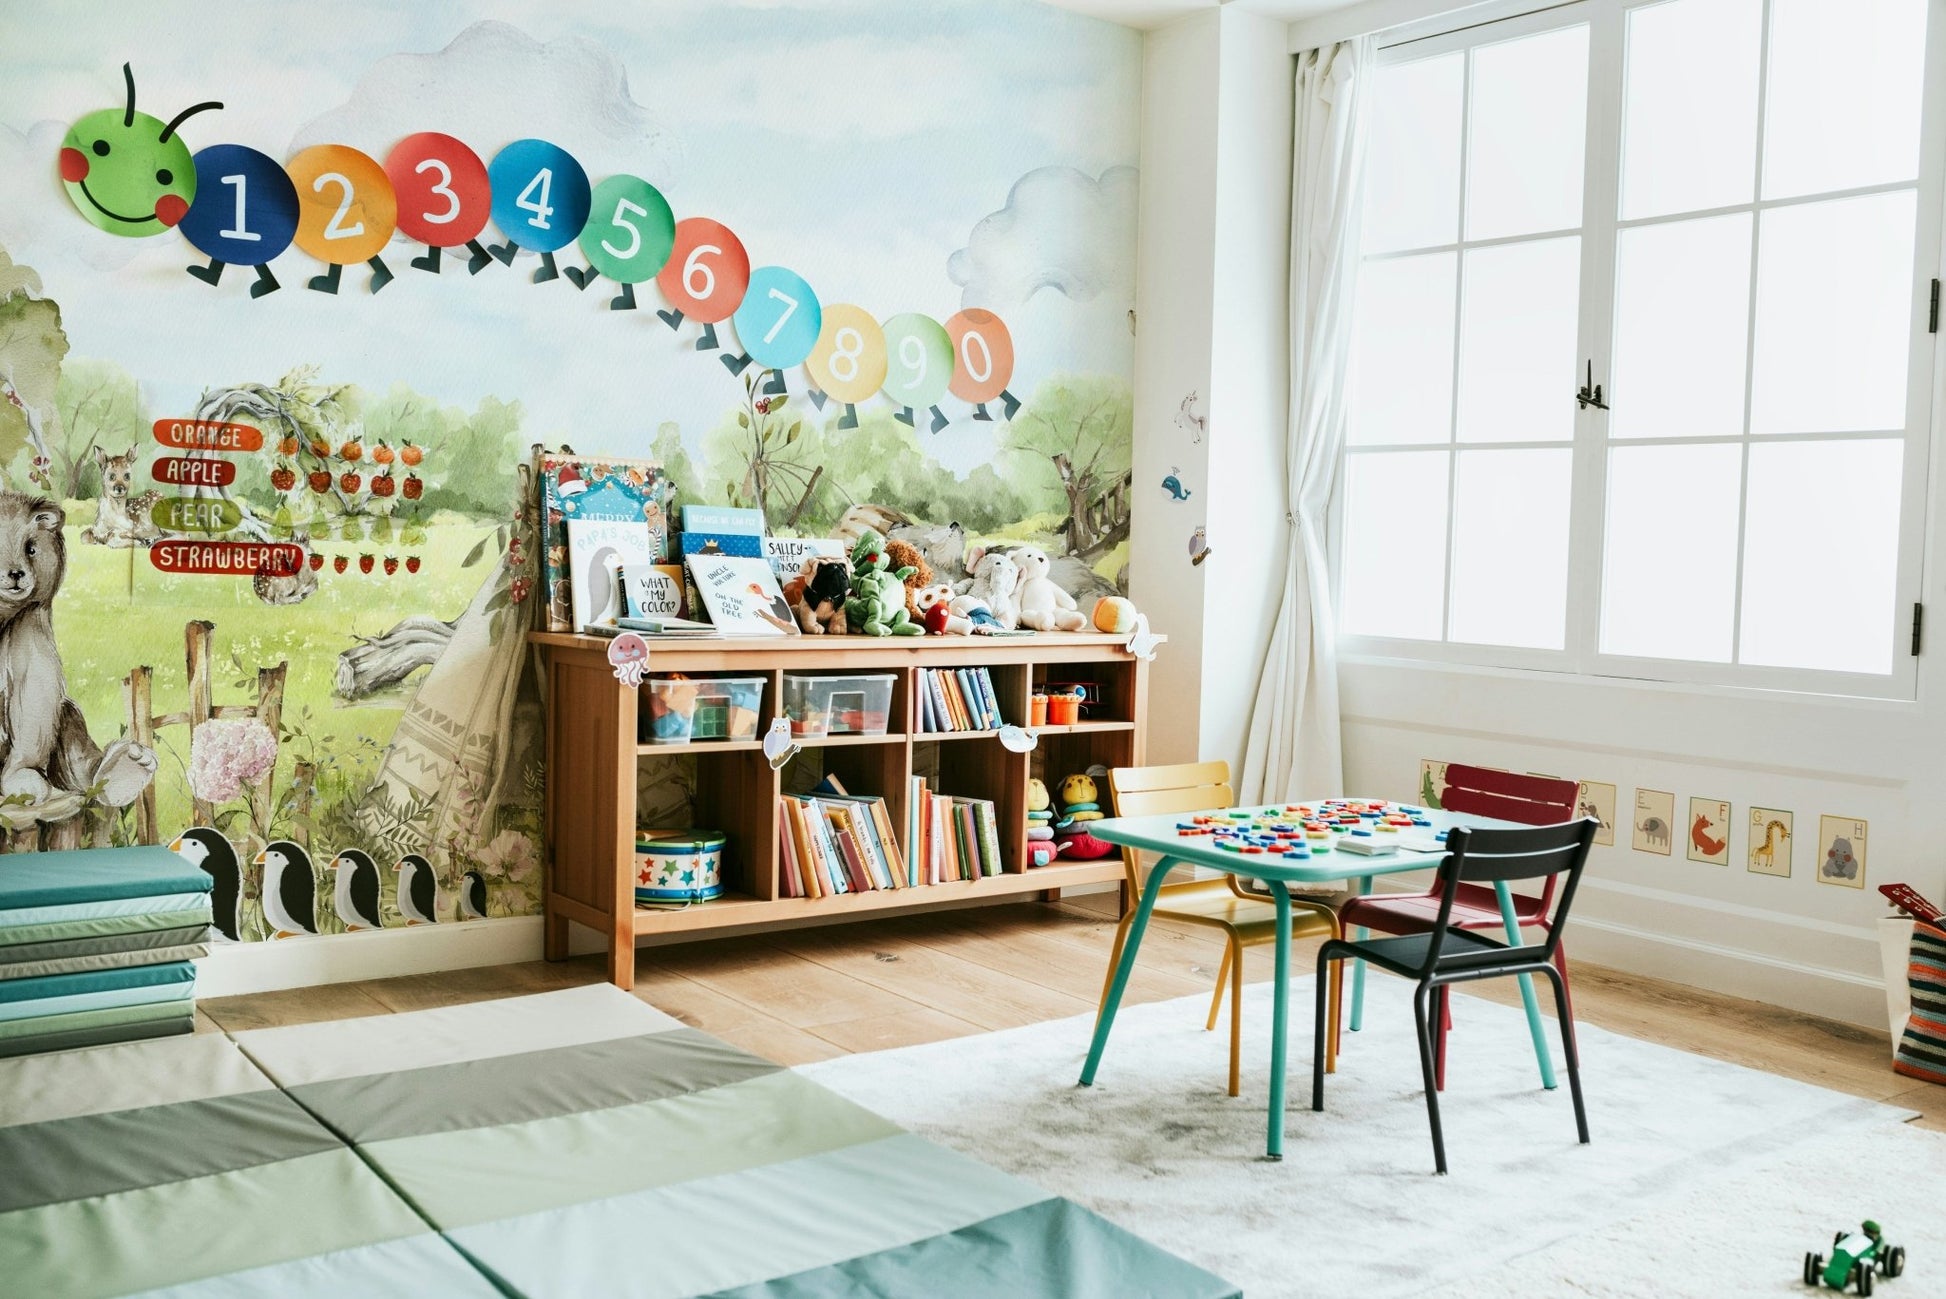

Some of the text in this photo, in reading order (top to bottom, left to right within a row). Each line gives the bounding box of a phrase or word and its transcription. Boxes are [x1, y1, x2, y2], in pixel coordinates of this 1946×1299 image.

[219, 158, 992, 390] 1 2 3 4 5 6 7 8 9 0
[170, 423, 242, 448] ORANGE
[167, 459, 222, 484] APPLE
[170, 503, 223, 528] PEAR
[577, 527, 646, 551] PAPA'S JOB
[768, 542, 803, 555] SALLEY
[159, 545, 296, 571] STRAWBERRY
[707, 565, 729, 580] UNCLE
[640, 577, 670, 589] WHAT
[650, 589, 666, 601] MY
[641, 601, 676, 613] COLOR?
[722, 602, 739, 611] OLD
[722, 608, 742, 619] TREE
[1438, 764, 1446, 776] A
[1580, 782, 1589, 795] D
[1638, 791, 1646, 805] E
[1719, 804, 1727, 817] F
[1752, 809, 1762, 823] G
[1854, 822, 1863, 836] H
